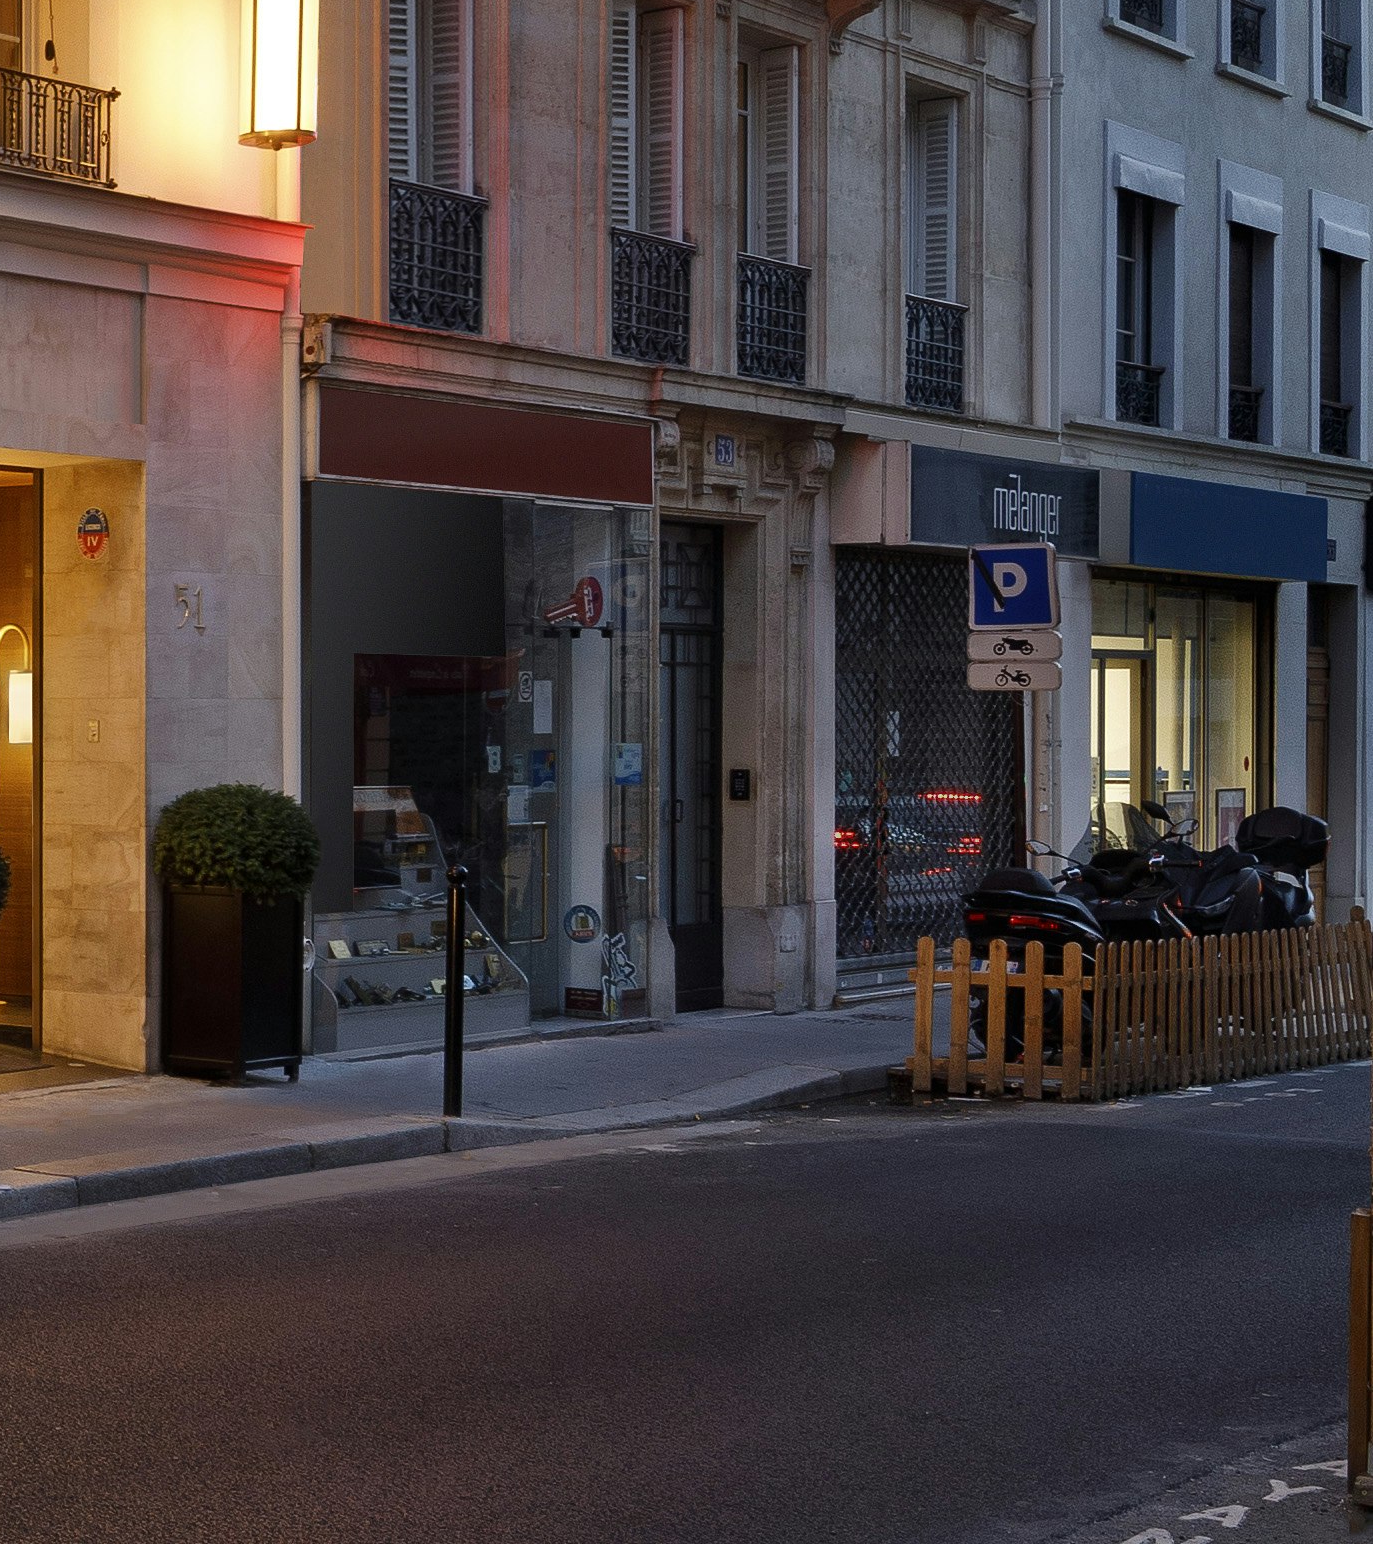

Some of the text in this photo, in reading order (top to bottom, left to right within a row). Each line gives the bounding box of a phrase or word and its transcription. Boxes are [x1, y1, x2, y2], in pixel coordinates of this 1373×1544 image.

[717, 438, 733, 463] 53
[87, 536, 99, 546] IV
[993, 562, 1028, 613] P
[174, 584, 206, 629] 51
